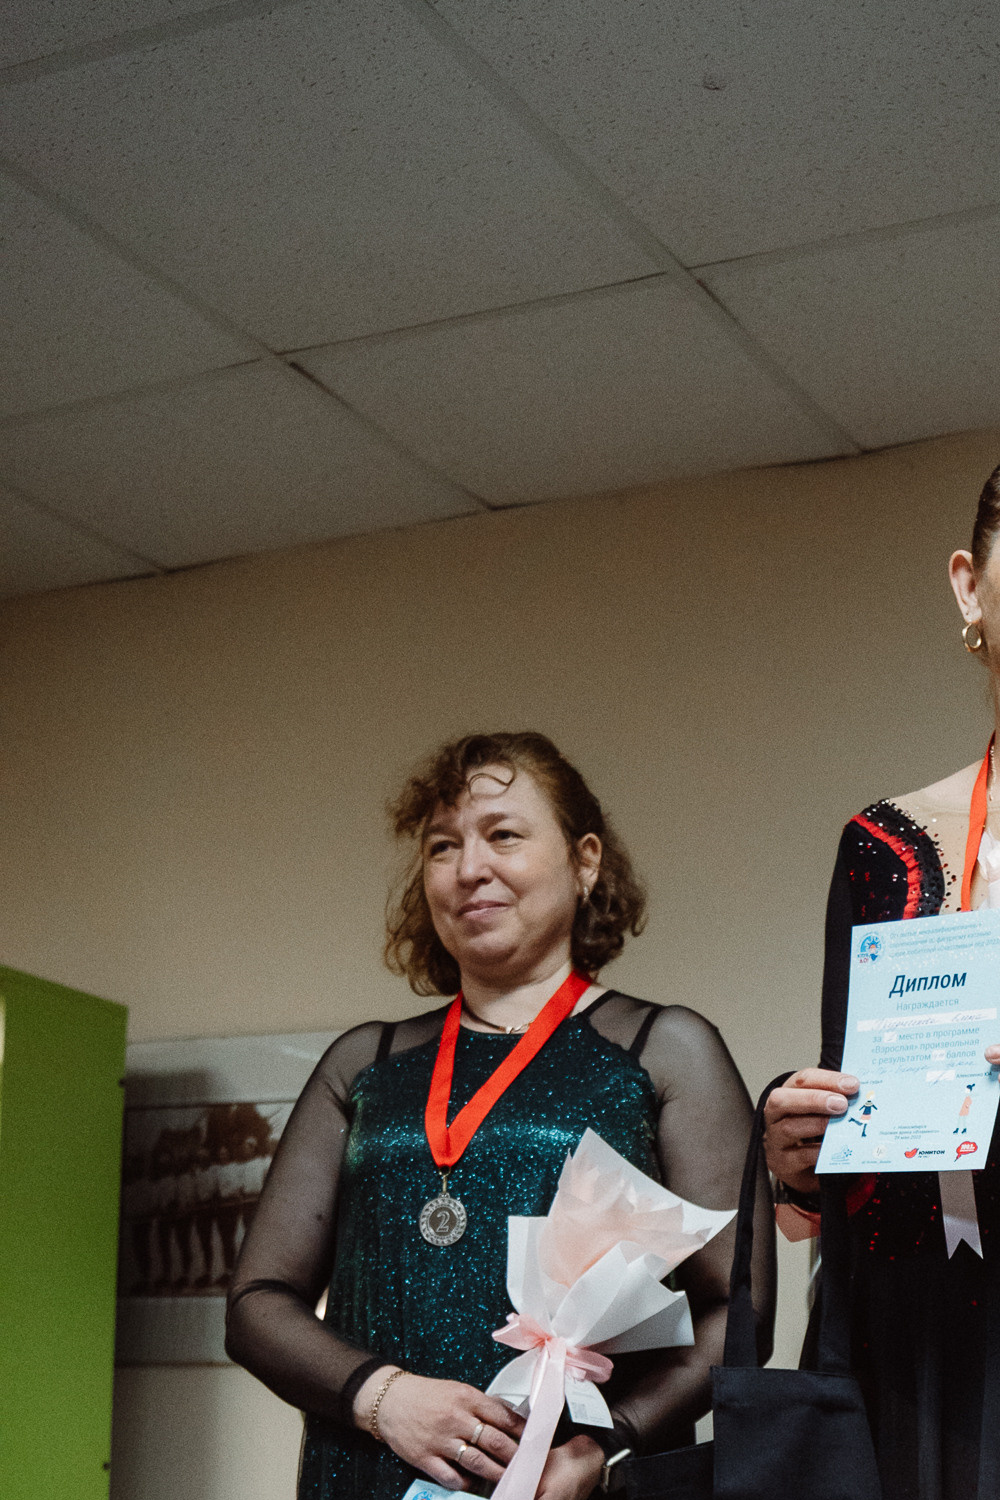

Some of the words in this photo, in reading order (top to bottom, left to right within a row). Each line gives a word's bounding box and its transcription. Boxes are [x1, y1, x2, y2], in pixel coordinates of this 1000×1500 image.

[888, 972, 967, 998] Диплом
[896, 998, 959, 1012] Награждается
[898, 1032, 924, 1041] место
[933, 1027, 980, 1039] программе
[878, 1053, 931, 1066] результатом
[946, 1050, 976, 1059] баллов
